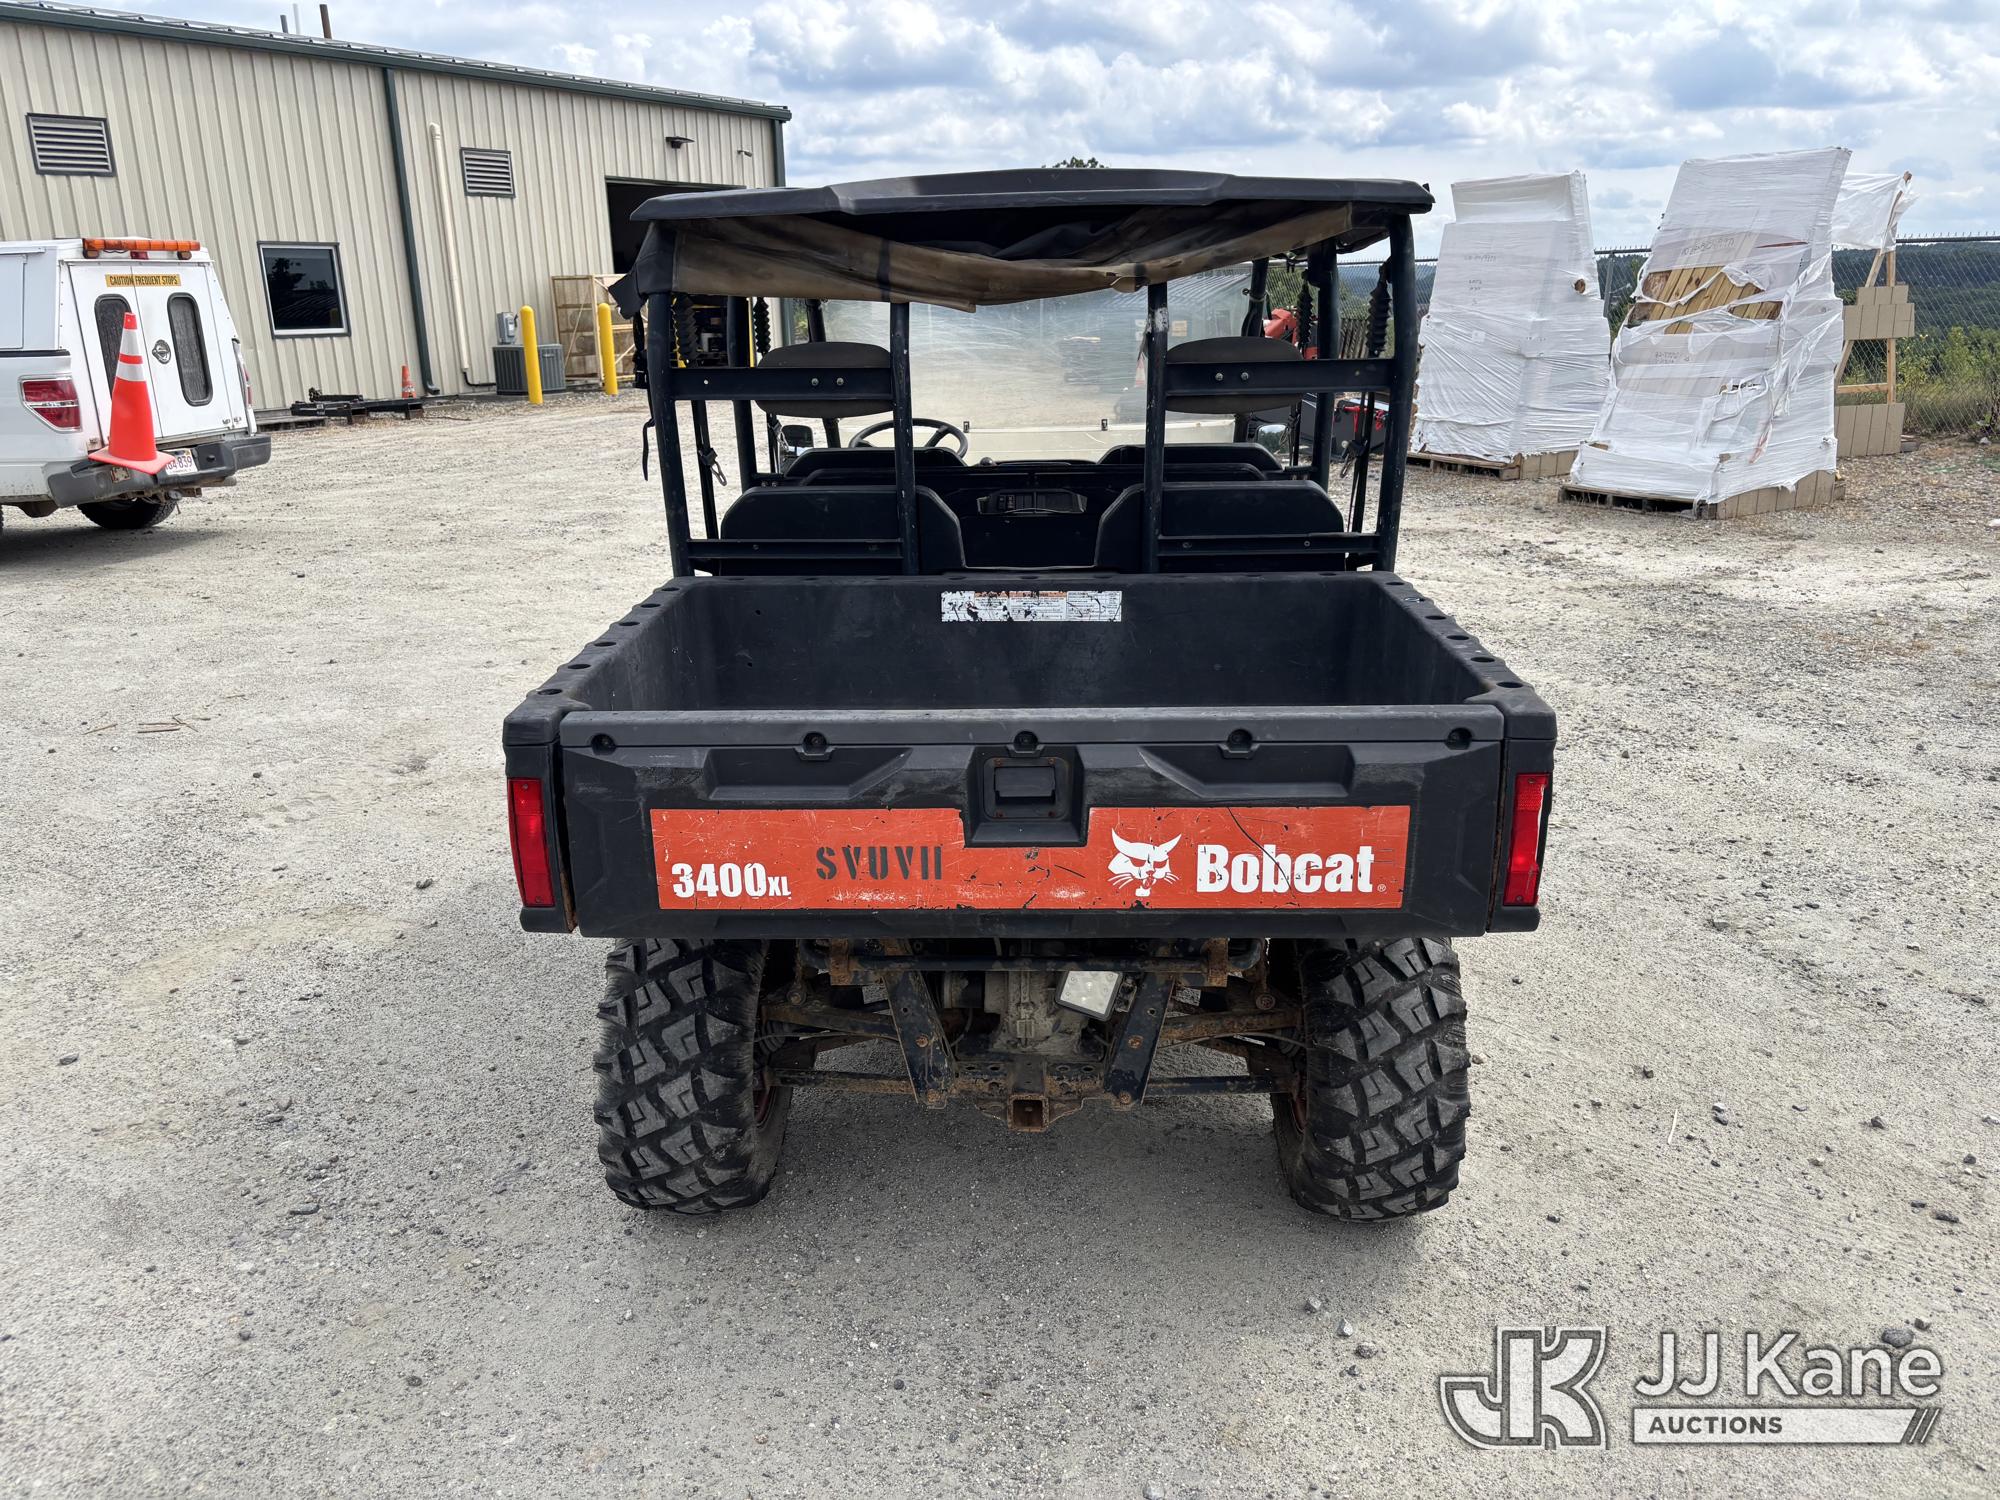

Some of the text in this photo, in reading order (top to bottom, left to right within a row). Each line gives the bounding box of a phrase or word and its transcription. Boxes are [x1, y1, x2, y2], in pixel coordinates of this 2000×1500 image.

[110, 275, 178, 286] CAUTION FREQUENT STOPS
[1196, 844, 1375, 893] Bobcat
